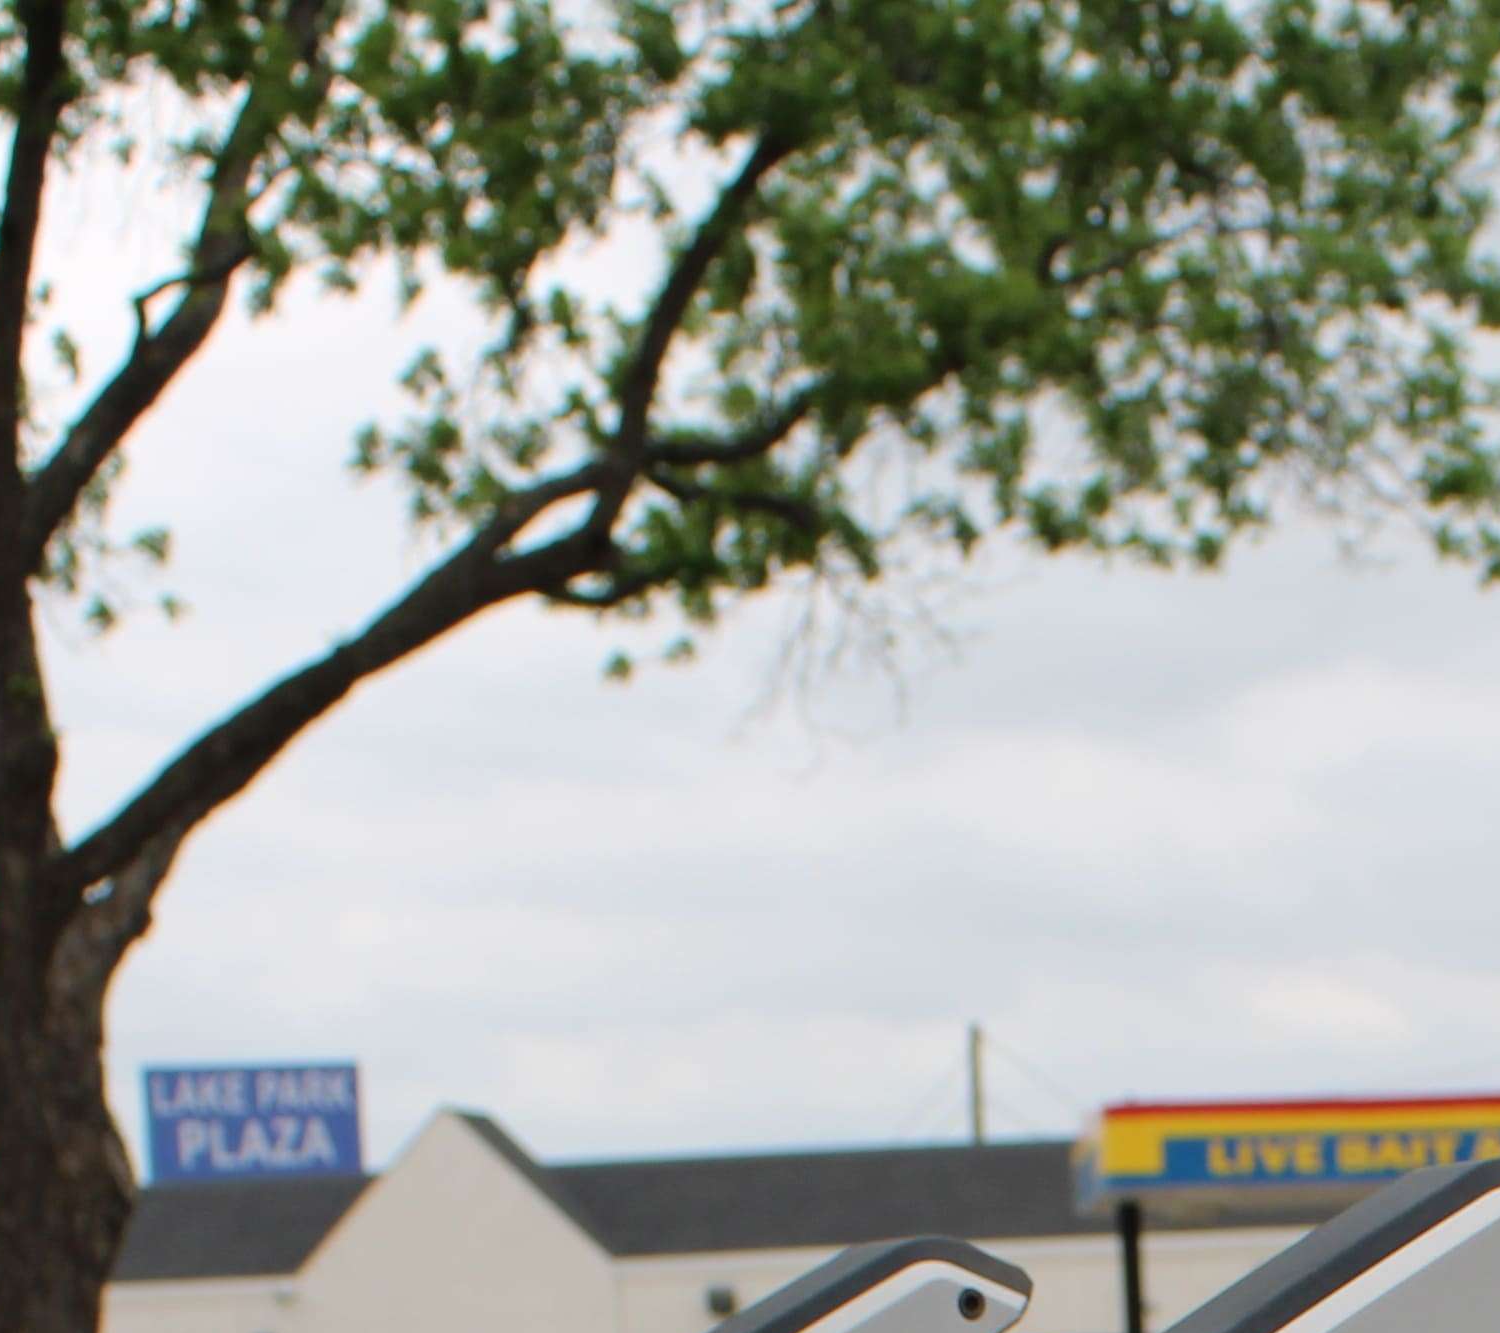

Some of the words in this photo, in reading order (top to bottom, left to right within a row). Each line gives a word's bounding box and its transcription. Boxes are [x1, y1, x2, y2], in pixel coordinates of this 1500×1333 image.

[152, 1070, 245, 1117] LAKE
[255, 1069, 350, 1112] PARK
[175, 1115, 339, 1171] PLAZA
[1206, 1135, 1322, 1176] LIVE
[1335, 1131, 1459, 1174] BAIT
